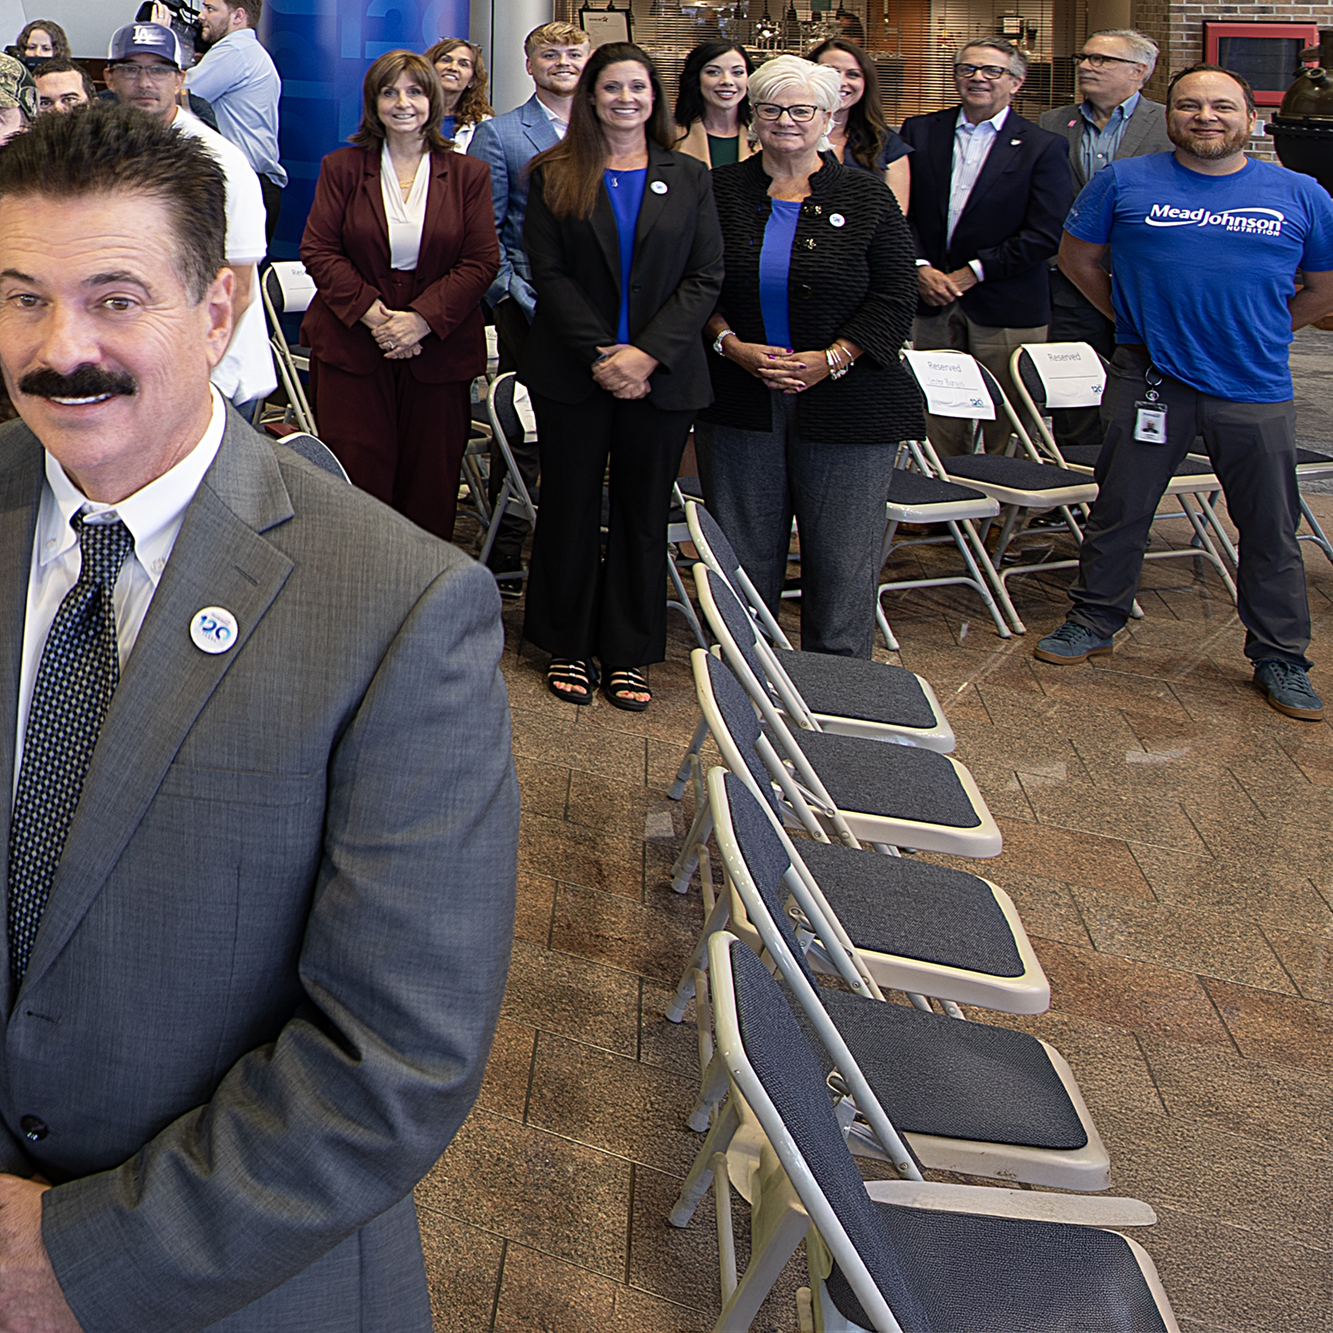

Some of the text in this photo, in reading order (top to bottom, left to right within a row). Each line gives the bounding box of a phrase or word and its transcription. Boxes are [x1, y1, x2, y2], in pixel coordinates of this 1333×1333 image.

[1151, 204, 1280, 232] MeadJohnson
[1226, 225, 1280, 237] NUTRITION
[1047, 351, 1082, 363] Reserved
[927, 360, 962, 373] Reserved
